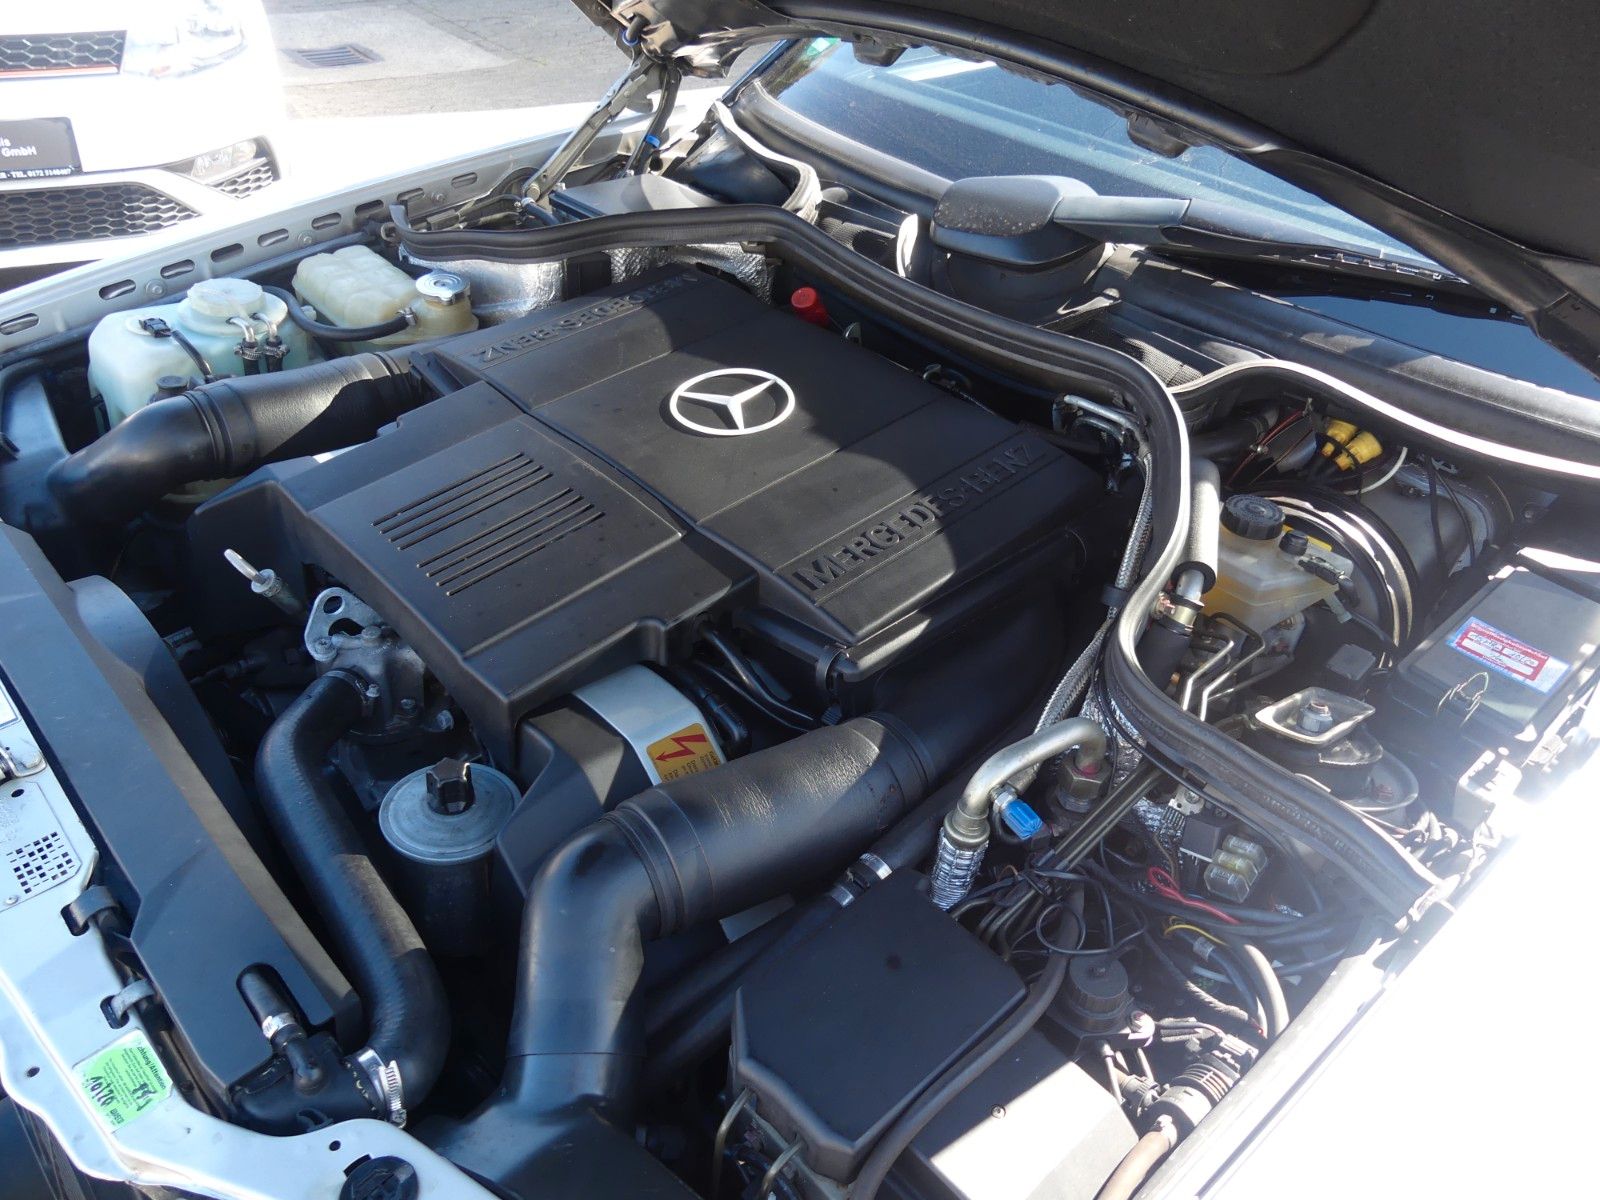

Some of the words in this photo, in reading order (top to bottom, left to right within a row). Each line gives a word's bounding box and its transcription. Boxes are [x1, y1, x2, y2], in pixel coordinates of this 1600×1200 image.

[1, 146, 37, 157] GmbH
[791, 442, 1041, 592] MERCEDES-BENZ
[137, 1044, 166, 1090] chtung/Attention
